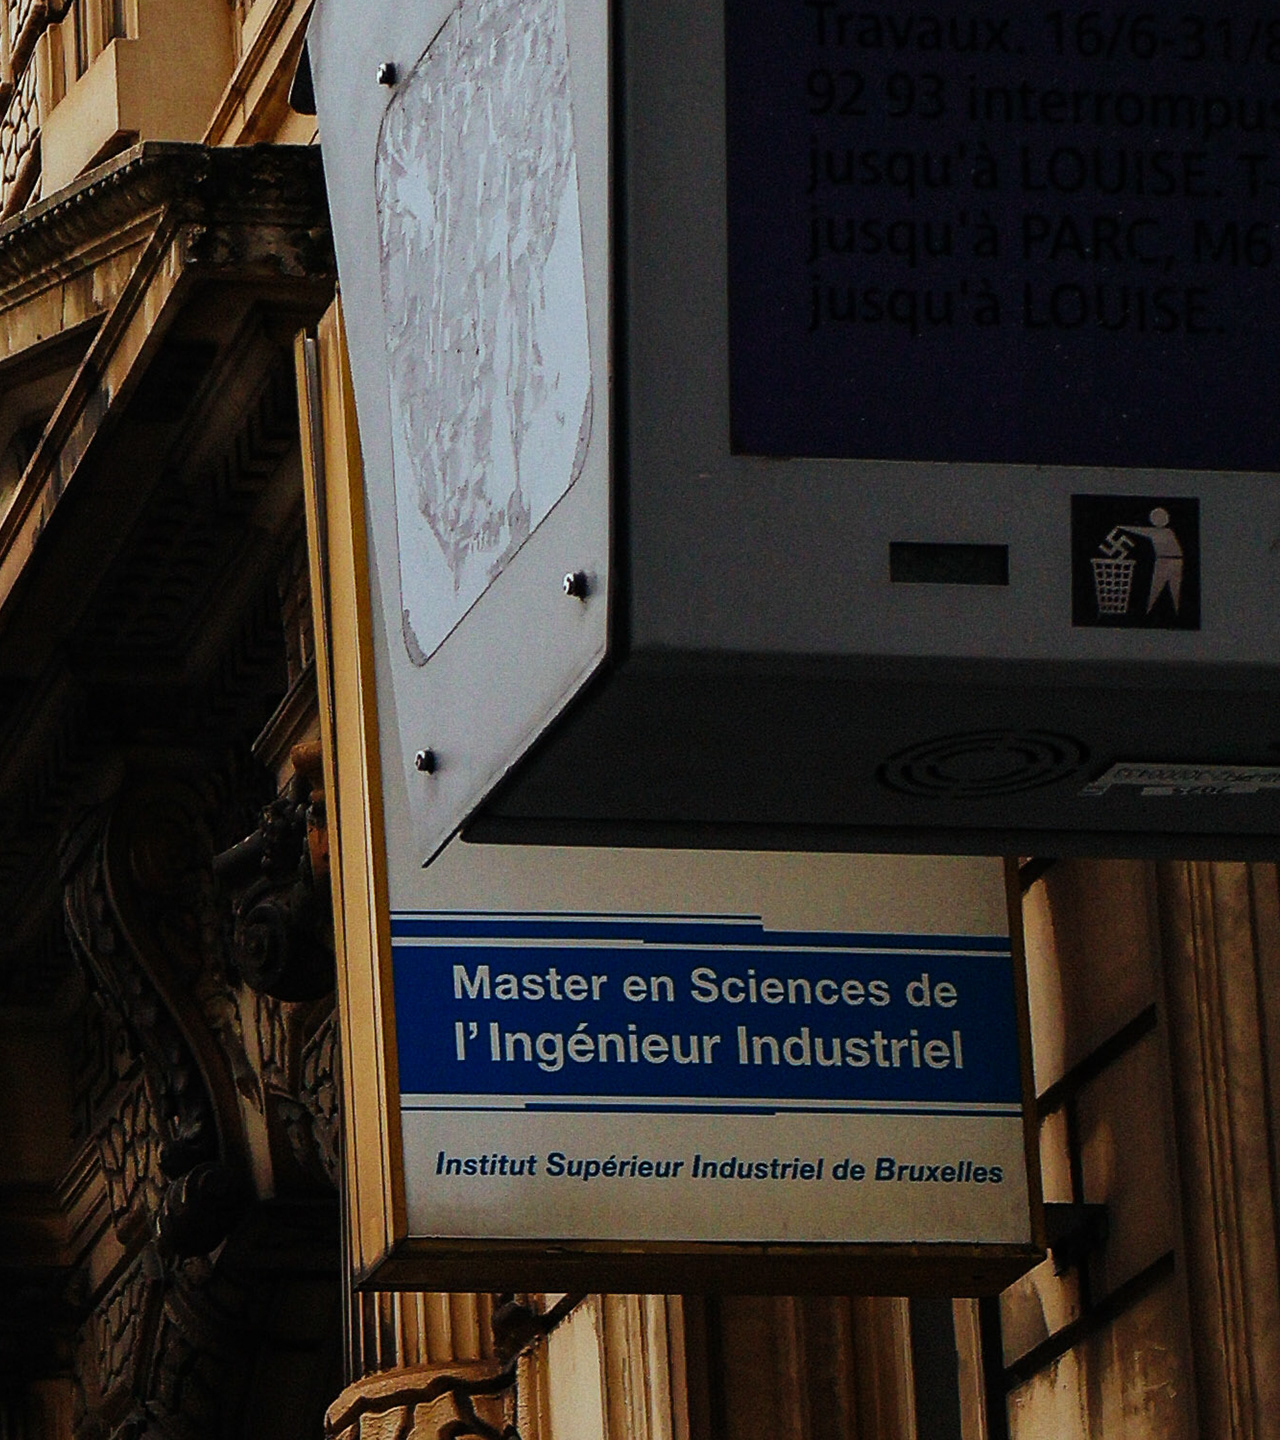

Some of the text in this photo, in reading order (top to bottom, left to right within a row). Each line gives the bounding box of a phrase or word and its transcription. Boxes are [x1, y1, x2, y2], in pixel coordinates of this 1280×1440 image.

[803, 0, 1027, 56] Travaux.
[805, 68, 867, 117] 92
[884, 70, 947, 119] 93
[807, 135, 999, 198] jusqu'à
[1020, 145, 1223, 198] LOUISE.
[807, 205, 1272, 274] jusqu'à PARC, M6
[808, 275, 1227, 337] jusqu'à LOUISE.
[452, 963, 958, 1008] Master en Sciences de
[737, 1025, 965, 1070] Industriel
[435, 1150, 1004, 1185] Institut Supérieur Industriel de Bruxelles
